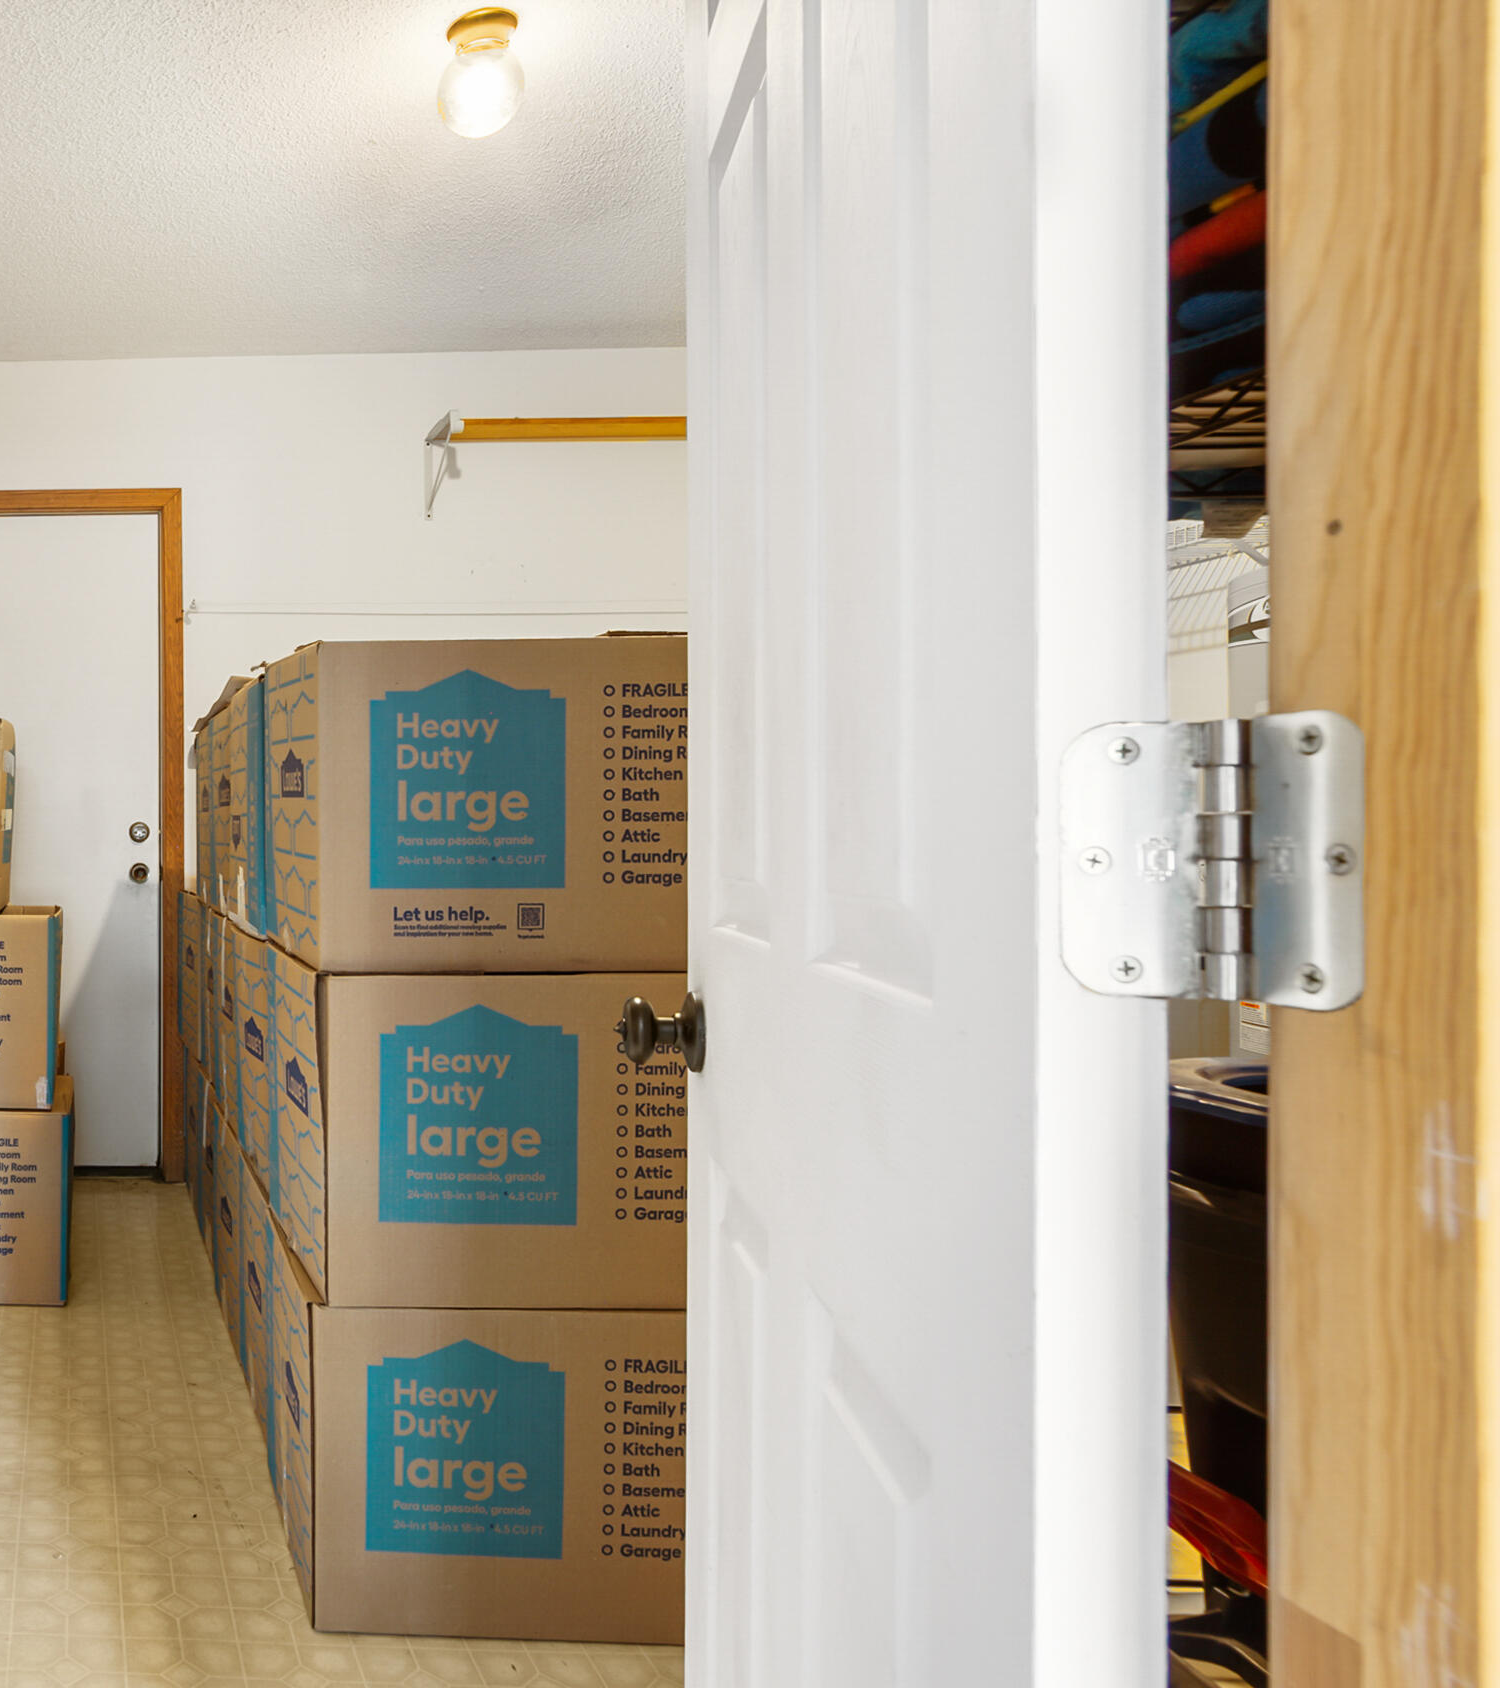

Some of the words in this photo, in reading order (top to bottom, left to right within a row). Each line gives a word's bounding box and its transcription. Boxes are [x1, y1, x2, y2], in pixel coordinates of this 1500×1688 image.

[397, 712, 499, 743] Heavy
[622, 725, 674, 741] Family
[396, 743, 474, 775] Duty
[622, 745, 673, 763] Dining
[622, 767, 683, 781] Kitchen
[622, 788, 660, 801] Bath
[397, 779, 530, 832] large
[622, 808, 688, 822] Baseme
[397, 836, 424, 846] Para
[426, 837, 445, 846] uso
[447, 835, 492, 847] pesado,
[493, 835, 535, 847] grande
[621, 828, 661, 843] Attic
[515, 854, 532, 865] CU
[534, 854, 547, 864] FT
[622, 848, 688, 866] Laundry
[621, 870, 682, 887] Garage
[393, 906, 421, 922] Let
[425, 909, 444, 922] us
[448, 906, 490, 924] help.
[406, 1046, 511, 1079] Heavy
[635, 1061, 687, 1078] Family
[406, 1077, 484, 1111] Duty
[635, 1082, 685, 1099] Dining
[635, 1103, 686, 1117] Kitche
[635, 1124, 672, 1138] Bath
[407, 1114, 542, 1168] large
[635, 1145, 688, 1158] Basem
[11, 1163, 37, 1171] Room
[634, 1165, 673, 1179] Attic
[10, 1175, 36, 1183] Room
[406, 1169, 433, 1180] Para
[435, 1171, 456, 1181] uso
[505, 1171, 546, 1184] grande
[545, 1191, 559, 1201] FT
[634, 1186, 687, 1200] Laund
[634, 1207, 687, 1223] Garag
[394, 1378, 498, 1414] Heavy
[623, 1401, 676, 1418] Family
[394, 1409, 471, 1444] Duty
[623, 1421, 674, 1439] Dining
[623, 1442, 684, 1456] Kitchen
[394, 1446, 527, 1501] large
[622, 1463, 660, 1477] Bath
[622, 1483, 686, 1498] Baseme
[393, 1500, 420, 1511] Para
[422, 1502, 442, 1512] uso
[491, 1505, 532, 1517] grande
[621, 1503, 660, 1517] Attic
[620, 1544, 681, 1561] Garage
